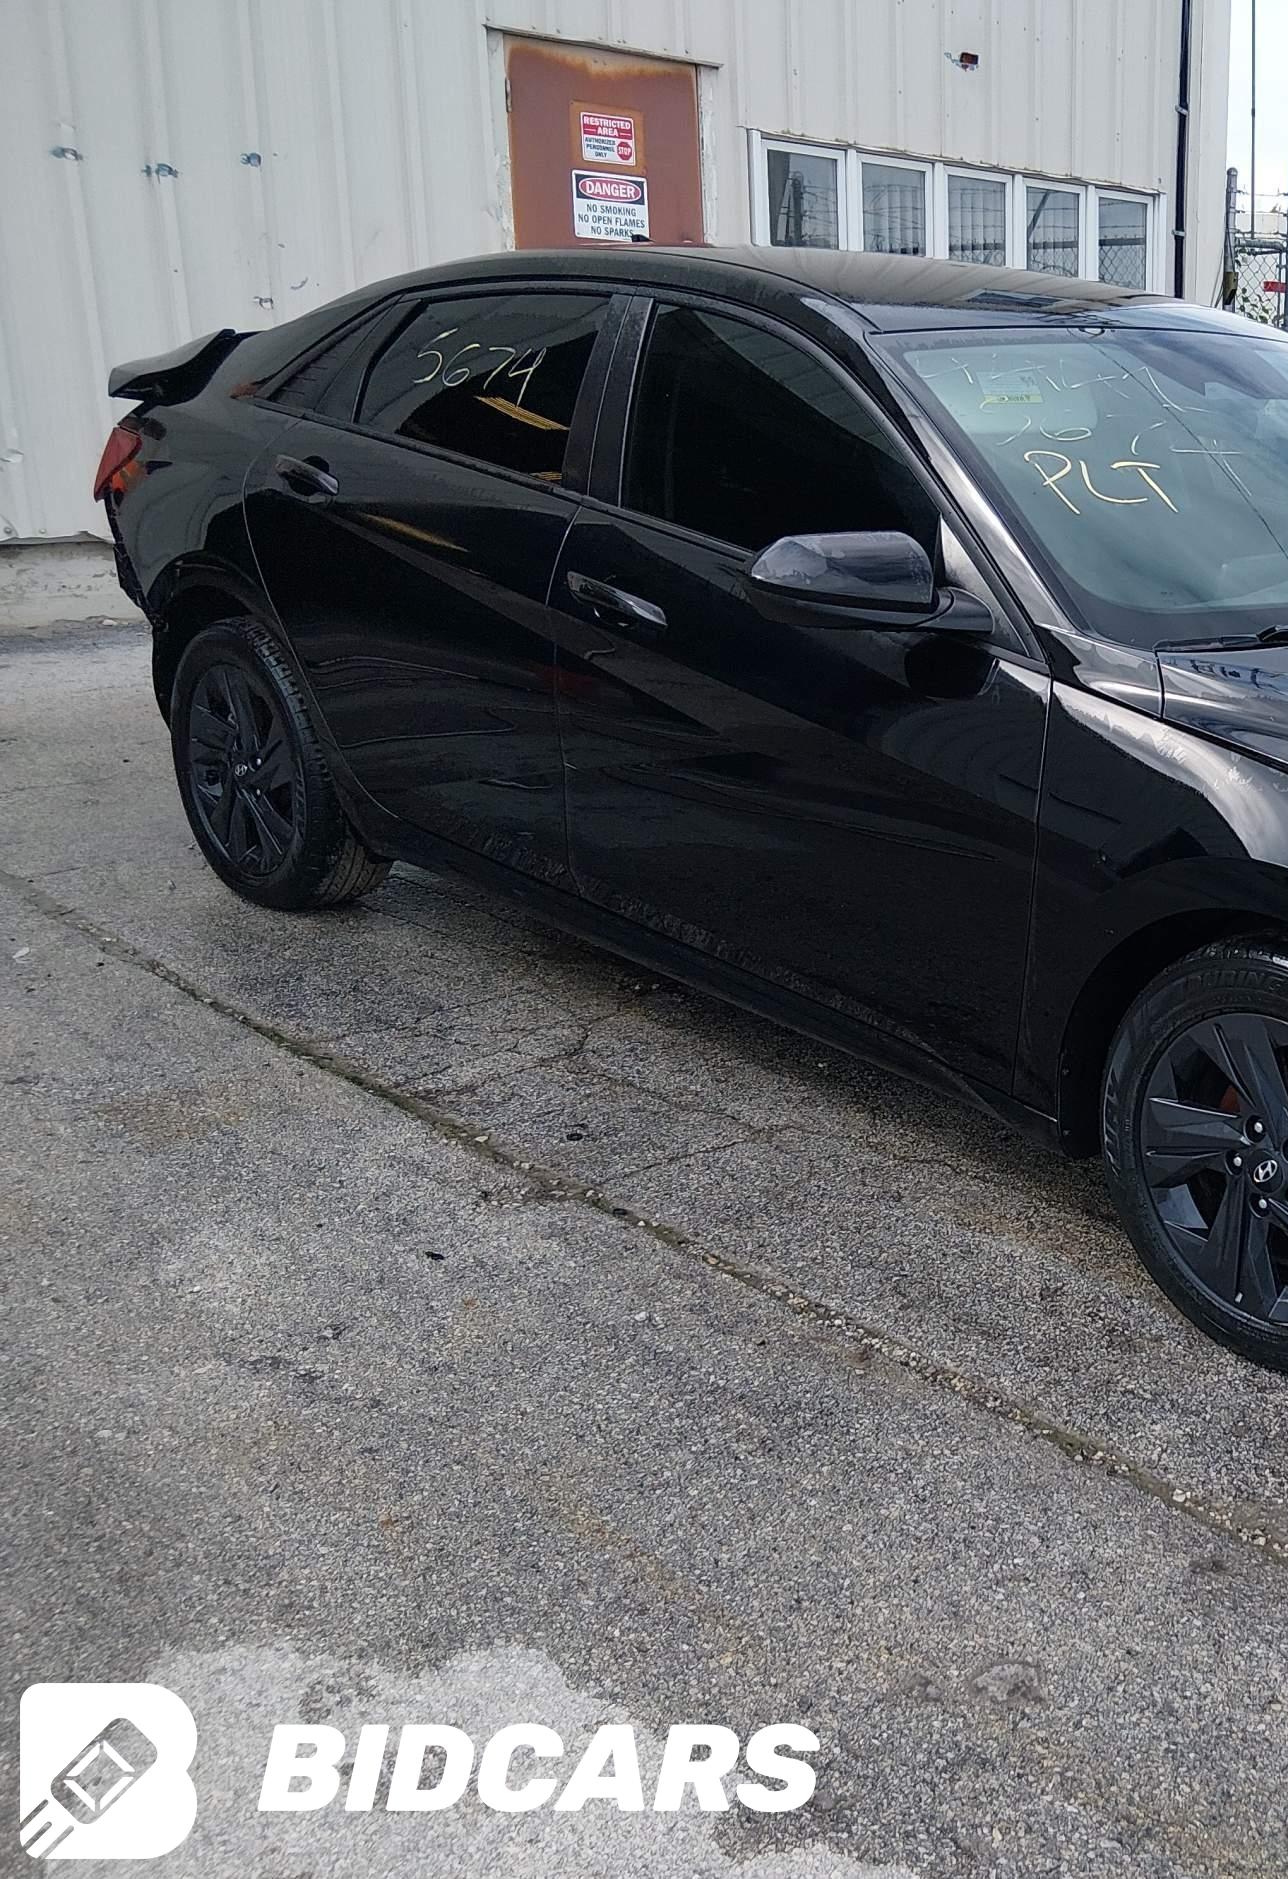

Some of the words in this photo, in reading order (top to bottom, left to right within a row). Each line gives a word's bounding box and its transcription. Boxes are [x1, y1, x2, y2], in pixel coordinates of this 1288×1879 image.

[583, 116, 631, 130] RESTRICTED
[597, 127, 619, 137] AREA
[585, 137, 615, 145] AUTHORIZED
[618, 146, 632, 155] STOP
[585, 180, 635, 198] DANGER
[586, 203, 598, 213] NO
[600, 205, 637, 217] SMOKING
[577, 213, 589, 223] NO
[592, 215, 613, 225] OPEN
[615, 217, 646, 229] FLAMES
[591, 226, 602, 235] NO
[604, 227, 634, 238] SPARKS
[413, 327, 547, 408] 5674
[1022, 450, 1179, 515] PLT
